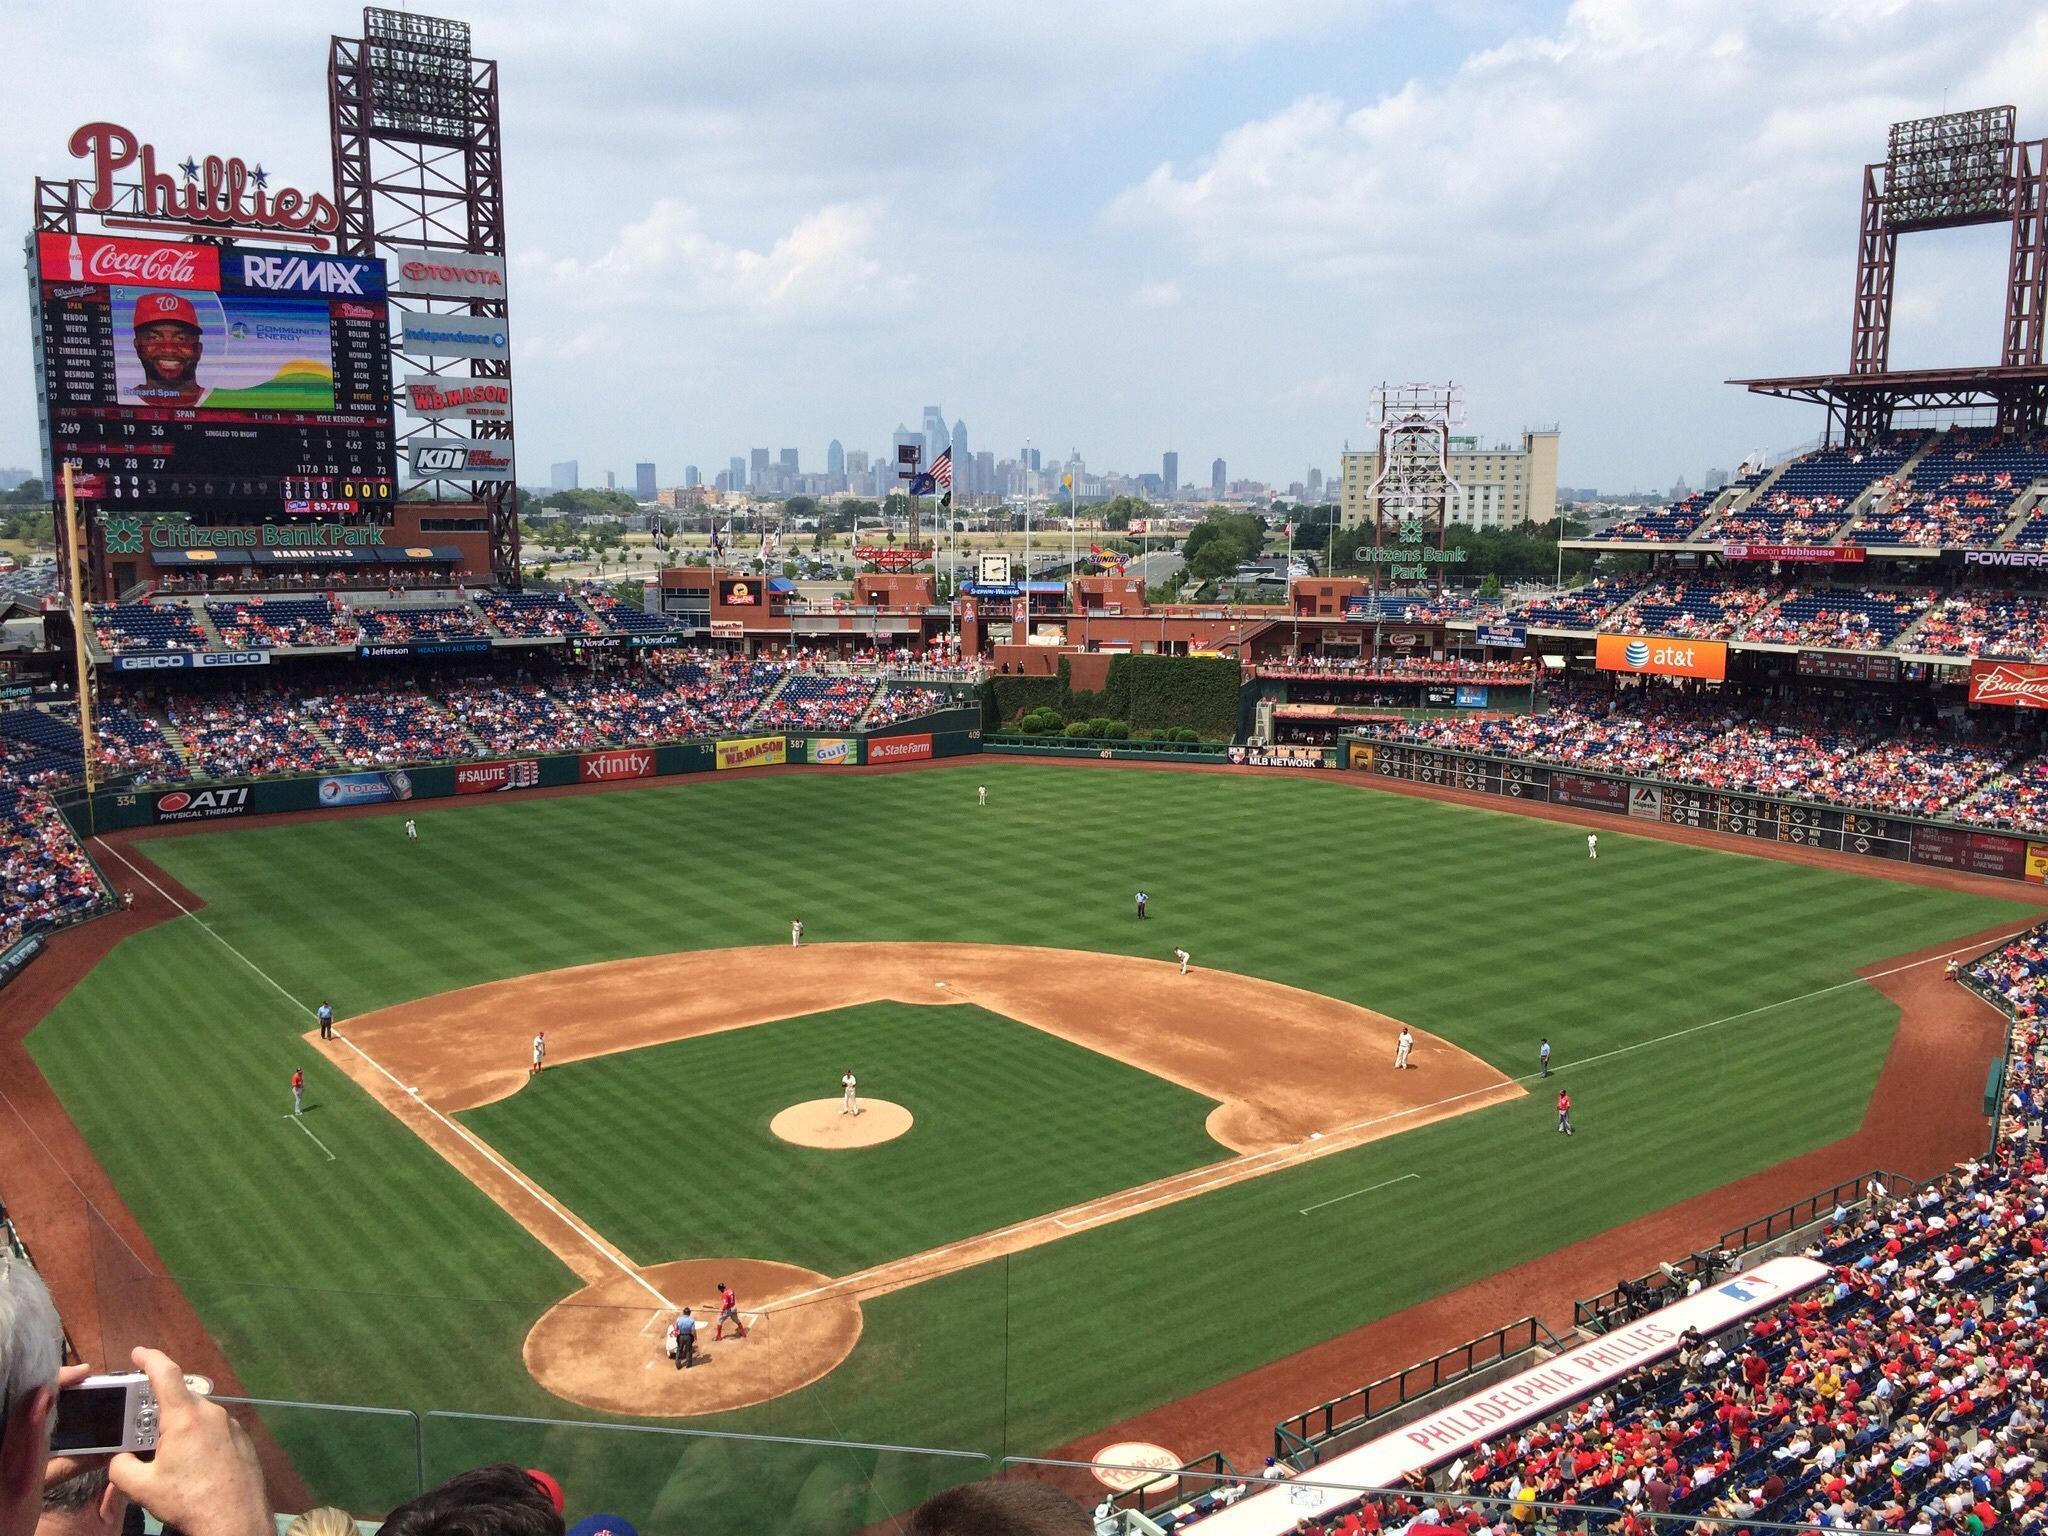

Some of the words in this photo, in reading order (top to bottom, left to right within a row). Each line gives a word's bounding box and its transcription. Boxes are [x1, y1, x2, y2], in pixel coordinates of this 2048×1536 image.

[68, 121, 340, 233] Phillies
[90, 244, 199, 282] Coca-Cola
[243, 254, 363, 295] RE/MAX
[427, 266, 502, 285] TOYOTA
[63, 314, 89, 322] RENDON
[66, 325, 87, 333] WERTH
[345, 320, 371, 328] SIZEMORE
[256, 324, 322, 335] COMMUNITY
[256, 333, 301, 343] ENERGY
[348, 331, 370, 339] ROLLINS
[405, 328, 490, 344] Independence
[59, 347, 97, 356] ZIMMERMAN
[348, 351, 372, 360] HOWARD
[67, 359, 91, 367] HARPER
[65, 371, 95, 379] DESMOND
[353, 372, 370, 380] ASCHE
[67, 382, 95, 390] LOBATON
[71, 393, 93, 401] ROARK
[158, 388, 180, 399] Span
[176, 411, 196, 419] SPAN
[316, 415, 332, 423] KYLE
[333, 415, 365, 424] KENDRICK
[58, 423, 81, 434] .269
[99, 424, 104, 435] 1
[123, 425, 135, 435] 19
[151, 426, 164, 436] 56
[303, 441, 308, 449] 4
[326, 441, 332, 449] 8
[346, 441, 362, 449] 4.62
[376, 442, 386, 450] 33
[98, 458, 110, 468] 94
[125, 459, 138, 469] 28
[153, 460, 166, 469] 27
[297, 465, 318, 473] 117.0
[325, 465, 339, 473] 128
[377, 467, 386, 475] 73
[114, 476, 120, 485] 3
[133, 476, 138, 485] 0
[286, 481, 291, 490] 3
[304, 482, 309, 490] 3
[322, 482, 327, 490] 0
[115, 488, 121, 498] 0
[133, 488, 139, 498] 0
[287, 491, 292, 499] 0
[305, 491, 310, 499] 0
[323, 491, 328, 499] 0
[345, 484, 353, 497] 0
[362, 484, 370, 497] 0
[379, 484, 387, 497] 0
[313, 502, 350, 511] $9,780
[150, 525, 257, 547] Citizens
[262, 523, 327, 546] Bank
[329, 523, 385, 546] Park
[273, 550, 315, 558] HARRY
[332, 550, 354, 558] K'S
[1355, 547, 1421, 562] Citizens
[1423, 546, 1466, 562] Bank
[1753, 546, 1780, 556] bacon
[1781, 547, 1836, 557] clubhouse
[1090, 555, 1126, 563] SUNOCO
[1391, 563, 1428, 579] Park
[970, 587, 1020, 596] SHERWIN-WILLIAMS
[582, 639, 620, 650] NovaCare
[641, 637, 678, 650] NovaCare
[371, 647, 409, 657] Jefferson
[1654, 647, 1695, 667] at&t
[121, 656, 184, 669] GEICO
[203, 653, 262, 665] GEICO
[968, 731, 980, 740] 409
[700, 744, 714, 754] 374
[790, 740, 804, 749] 387
[817, 744, 847, 760] Gulf
[1100, 750, 1112, 759] 401
[586, 753, 650, 778] xfinity
[1249, 757, 1268, 766] MLB
[1270, 758, 1316, 768] NETWORK
[459, 768, 505, 783] #SALUTE
[344, 782, 388, 792] TOTAL
[116, 795, 136, 806] 334
[189, 787, 249, 809] ATI
[1633, 800, 1657, 809] Majestic
[1689, 800, 1700, 809] CIN
[160, 810, 202, 821] PHYSICAL
[205, 805, 244, 817] THERAPY
[1747, 819, 1757, 828] ATL
[1811, 819, 1819, 827] SF
[1877, 829, 1885, 837] LA
[1406, 1366, 1583, 1452] PHILADELPHIA
[1571, 1323, 1676, 1373] PHILLIES
